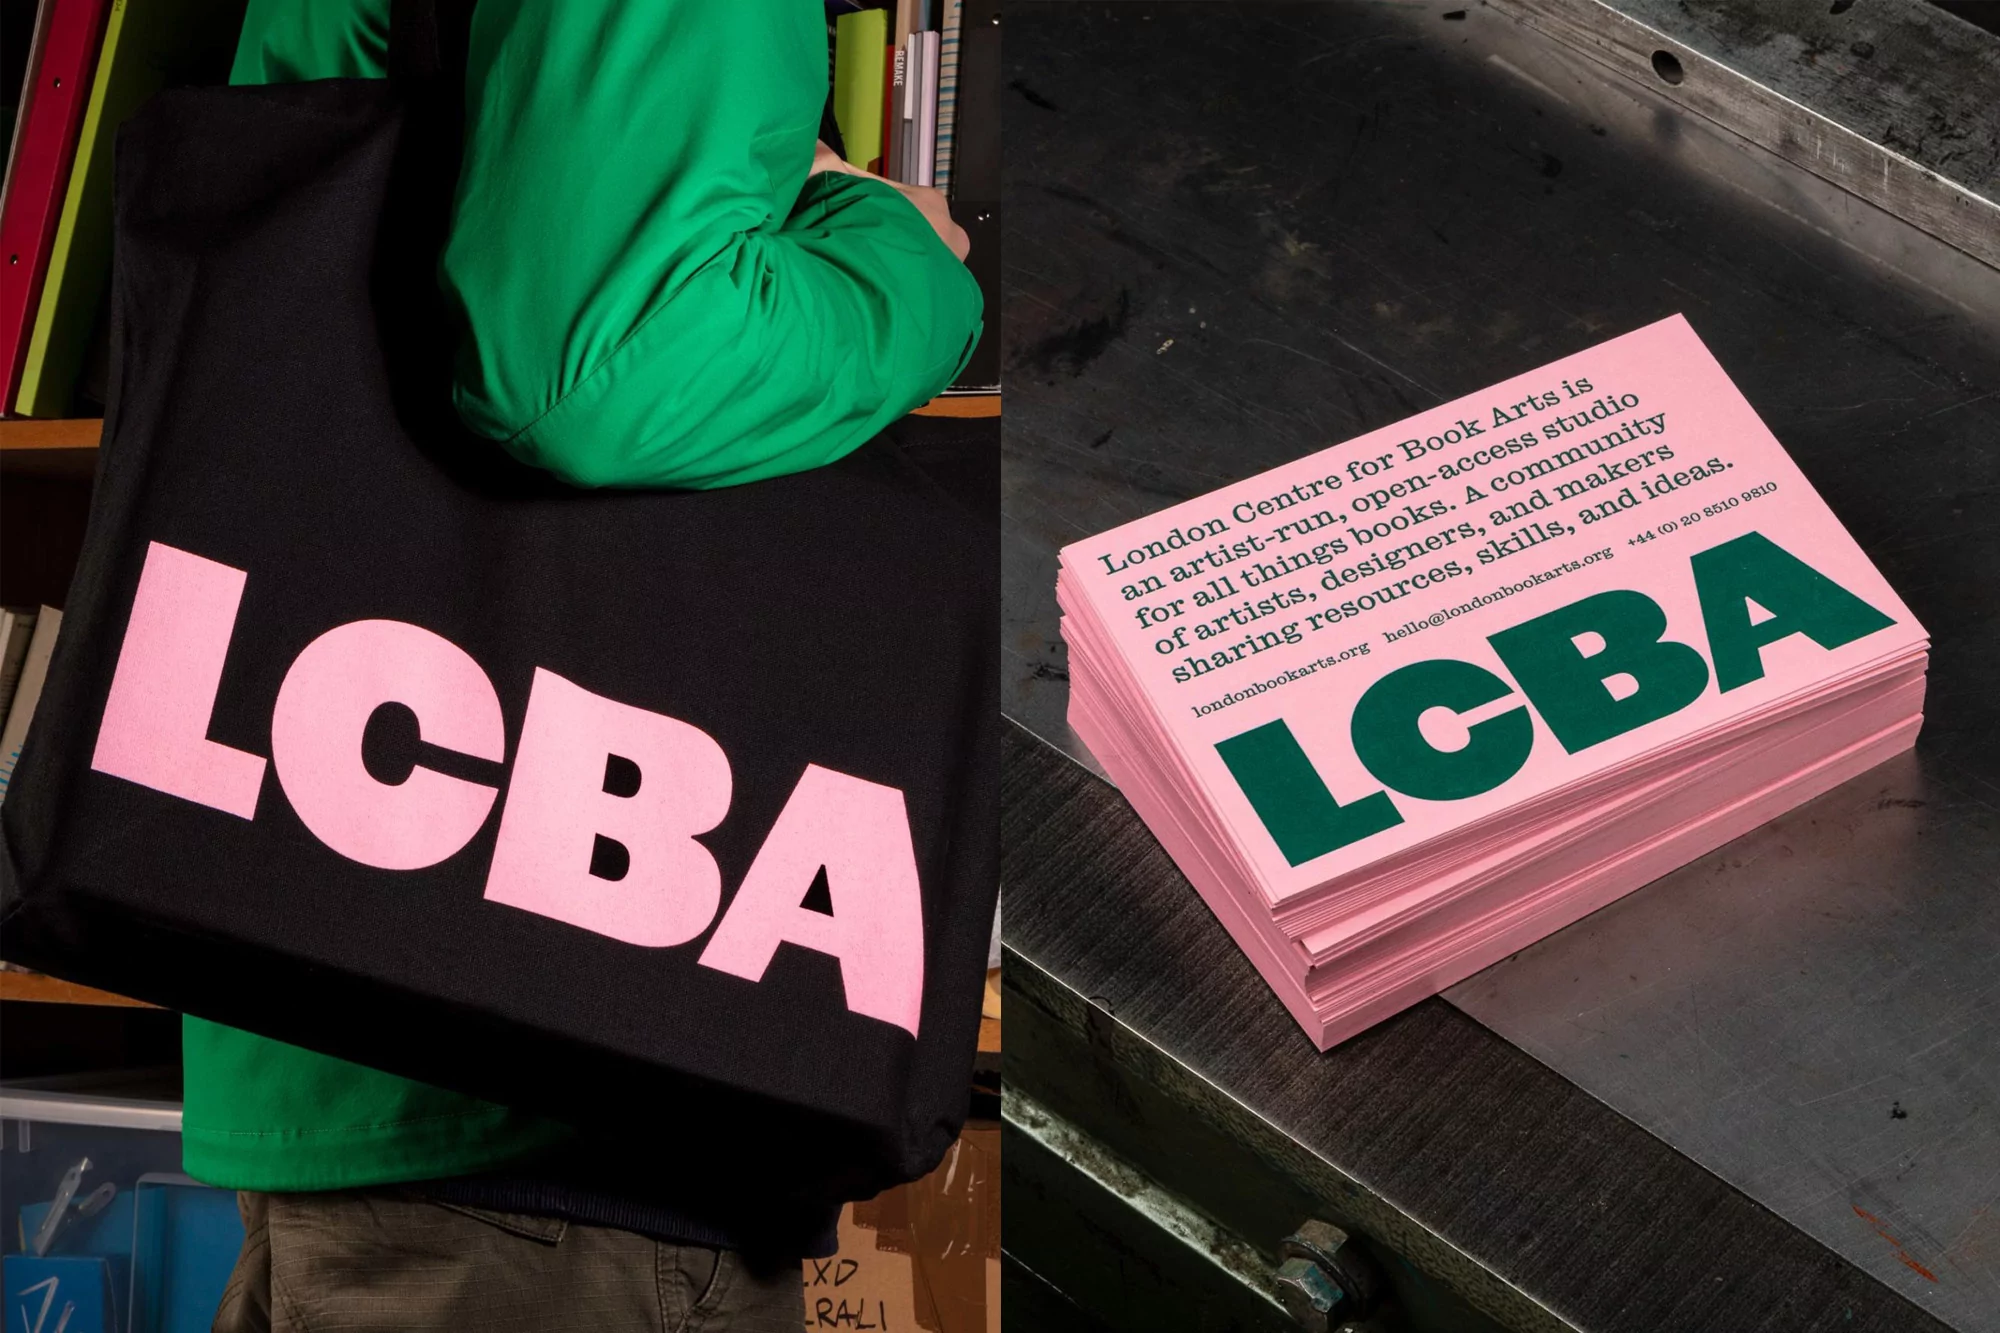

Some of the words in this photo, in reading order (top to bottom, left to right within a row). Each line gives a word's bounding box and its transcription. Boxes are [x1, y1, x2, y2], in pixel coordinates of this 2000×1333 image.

[893, 50, 904, 87] REMAKE
[1098, 519, 1230, 575] London
[1233, 475, 1342, 523] Centre
[1346, 454, 1394, 482] for
[1397, 420, 1486, 461] Book
[1493, 391, 1560, 428] Arts
[1562, 378, 1593, 398] is
[1121, 576, 1166, 601] an
[1170, 511, 1347, 582] artist-run,
[1352, 432, 1538, 512] open-access
[1542, 394, 1639, 439] studio
[1135, 599, 1184, 629] for
[1193, 576, 1240, 607] all
[1240, 538, 1348, 587] things
[1347, 500, 1456, 545] books.
[1466, 486, 1488, 504] A
[1491, 413, 1665, 491] community
[1155, 627, 1189, 654] of
[1194, 588, 1317, 640] artists,
[1321, 522, 1486, 590] designers,
[1489, 489, 1553, 526] and
[1553, 445, 1674, 501] makers
[1172, 622, 1302, 683] sharing
[1305, 561, 1473, 631] resources,
[1476, 521, 1575, 565] skills,
[1579, 488, 1642, 524] and
[1641, 458, 1733, 499] ideas.
[1628, 531, 1656, 545] +44
[1658, 522, 1678, 534] (0)
[1680, 513, 1701, 526] 20
[1703, 498, 1739, 517] 8510
[1741, 482, 1777, 501] 9810
[1192, 643, 1370, 718] londonbookarts.org
[1383, 548, 1614, 643] hello@londonbookarts.org
[91, 541, 924, 1038] LCBA
[1214, 531, 1898, 868] LCBA
[804, 1259, 858, 1287] XD
[805, 1298, 887, 1331] RALI
